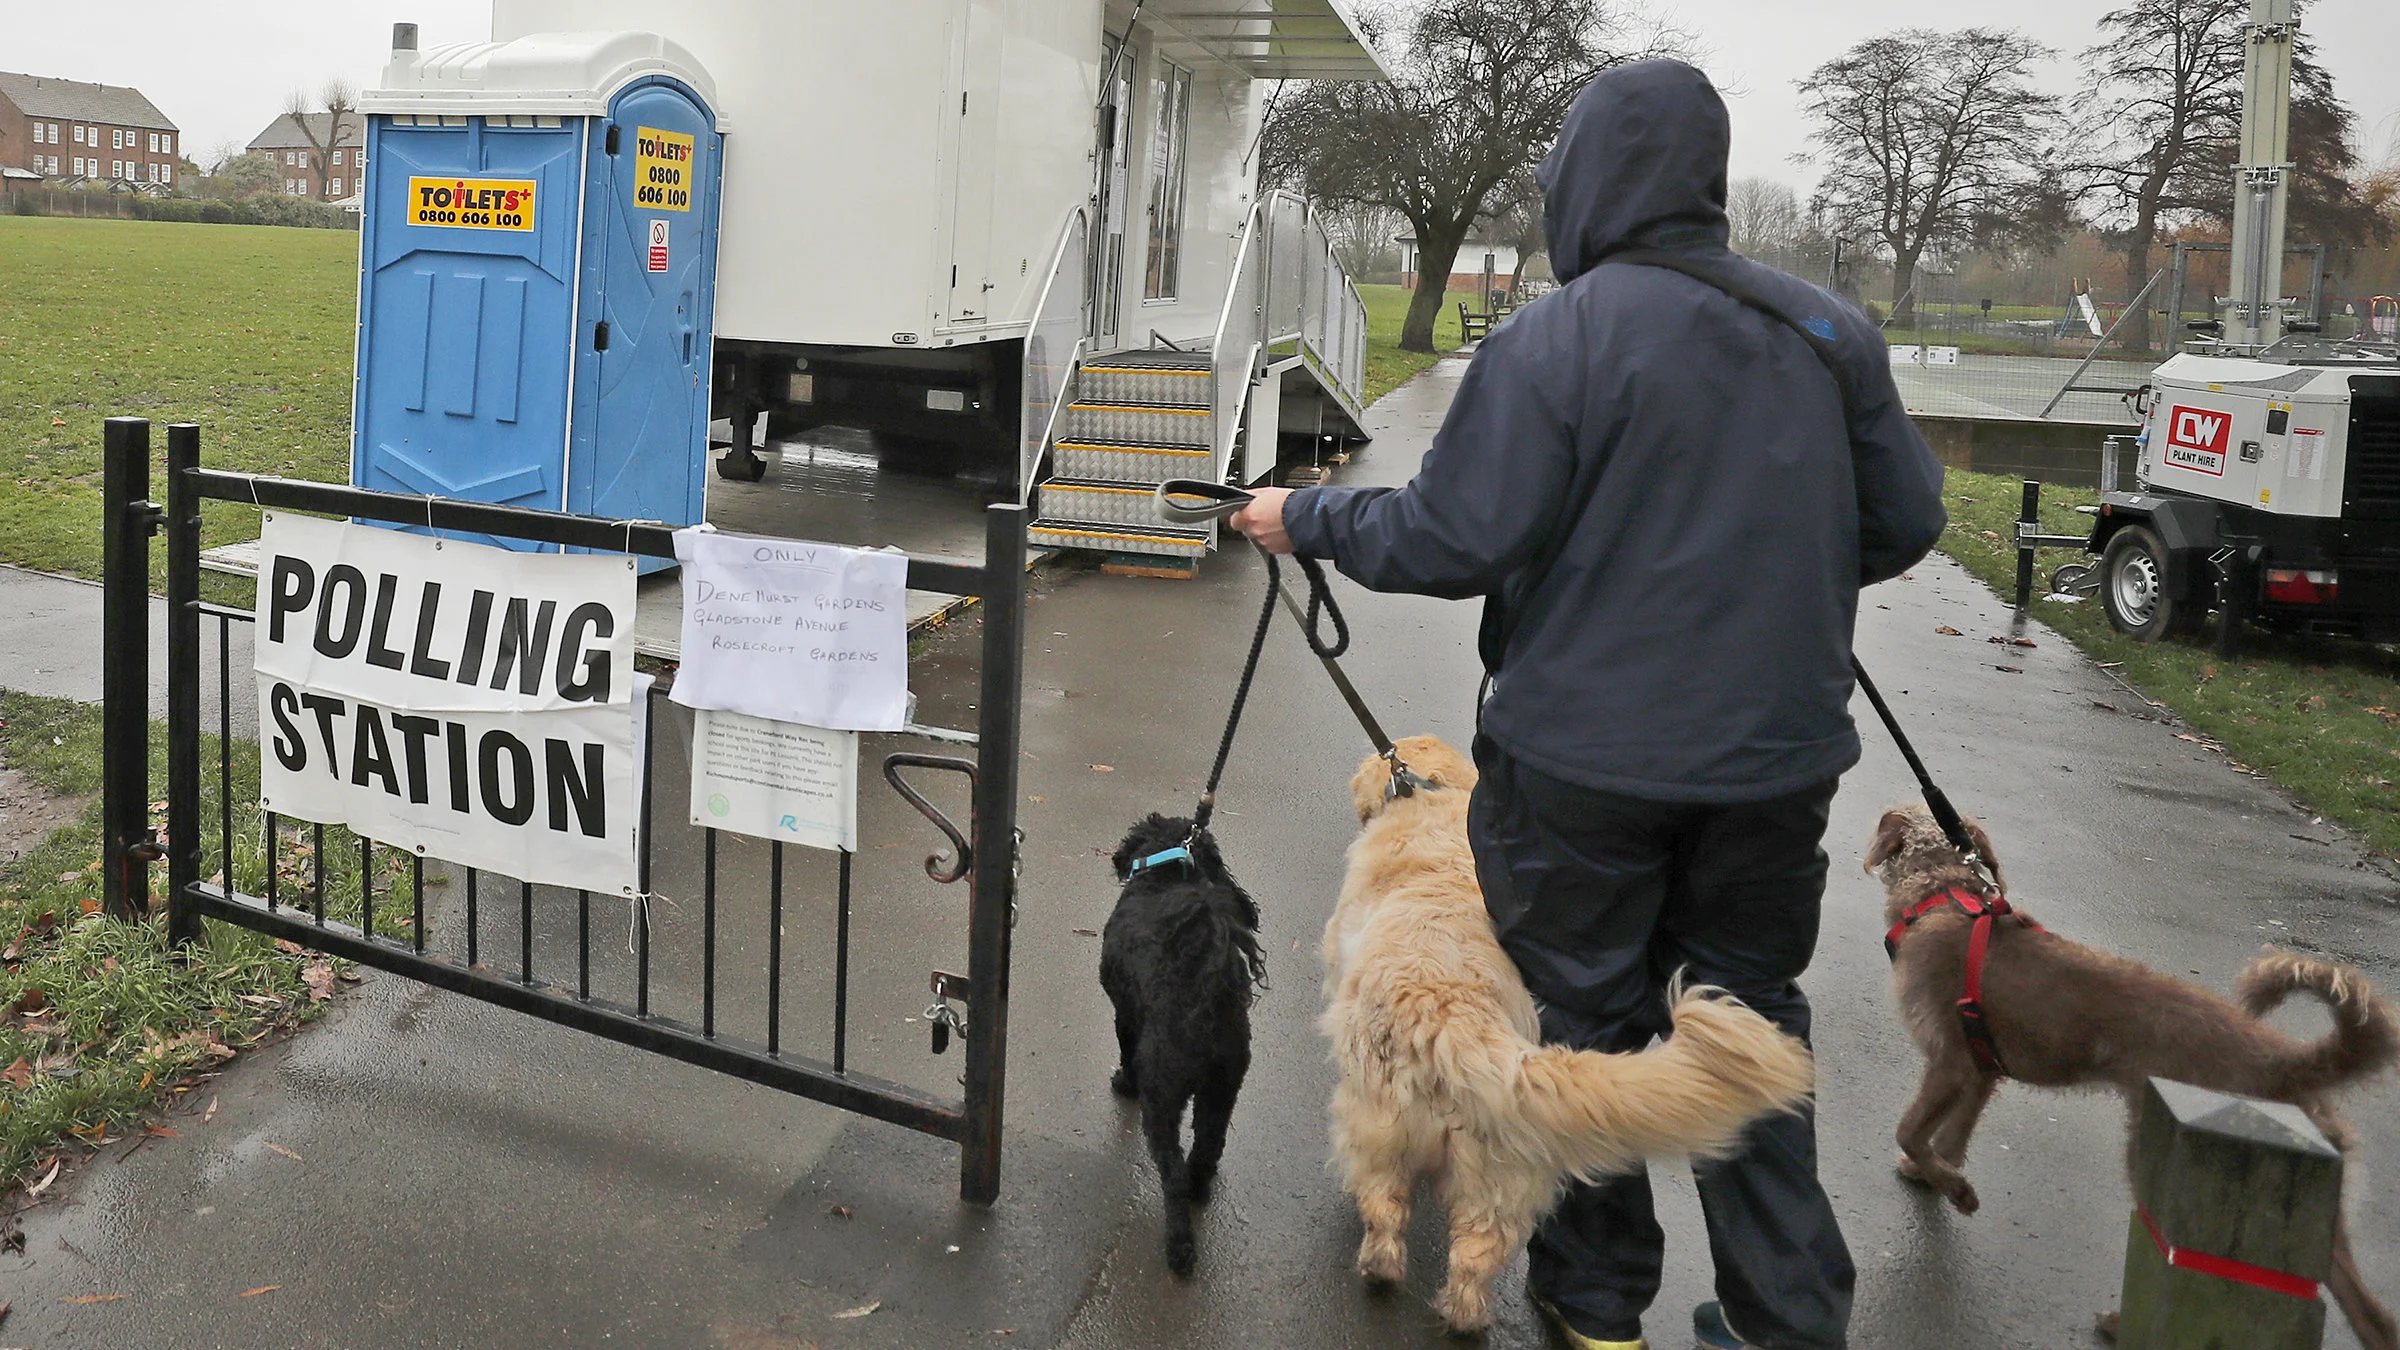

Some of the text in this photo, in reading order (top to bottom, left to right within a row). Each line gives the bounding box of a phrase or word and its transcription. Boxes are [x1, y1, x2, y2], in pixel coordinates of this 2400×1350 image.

[649, 165, 681, 186] 0800
[638, 185, 687, 207] 606 100
[419, 209, 522, 227] 0800 606 100
[2176, 411, 2222, 447] CW
[2172, 449, 2216, 468] PLANT HIRE
[753, 546, 817, 563] ONLY
[814, 593, 885, 612] GARDENS
[269, 554, 615, 703] POLLING
[693, 608, 850, 633] GLADSTONE AVENUE
[712, 635, 880, 662] ROSECROFT GARDENS
[271, 681, 605, 839] STATION
